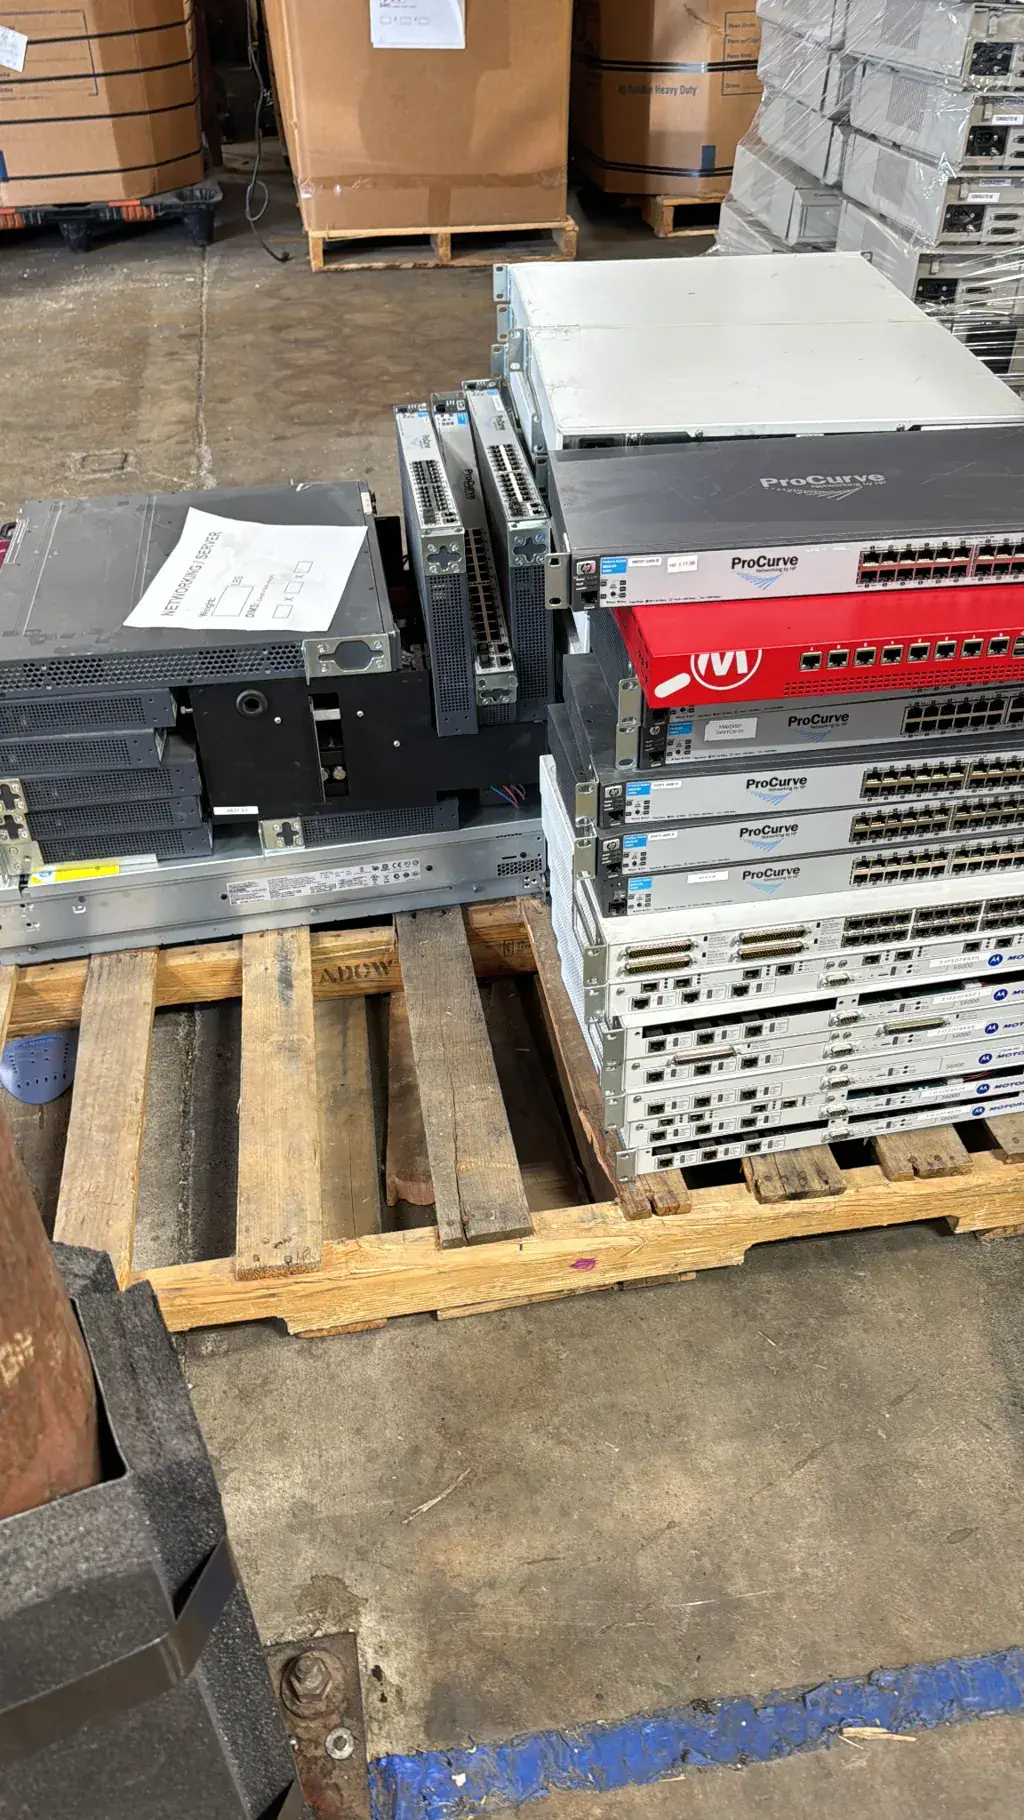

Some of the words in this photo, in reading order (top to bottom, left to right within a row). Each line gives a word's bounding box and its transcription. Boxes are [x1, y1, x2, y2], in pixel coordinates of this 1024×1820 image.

[655, 84, 678, 96] Heavy
[680, 84, 698, 97] Duty
[759, 473, 886, 489] ProCurve
[731, 555, 799, 570] ProCurve
[161, 563, 203, 617] NETWORKING
[195, 531, 223, 560] SERVER
[788, 713, 850, 727] ProCurve
[746, 777, 808, 789] ProCurve
[739, 824, 799, 837] ProCurve
[742, 867, 800, 881] ProCurve
